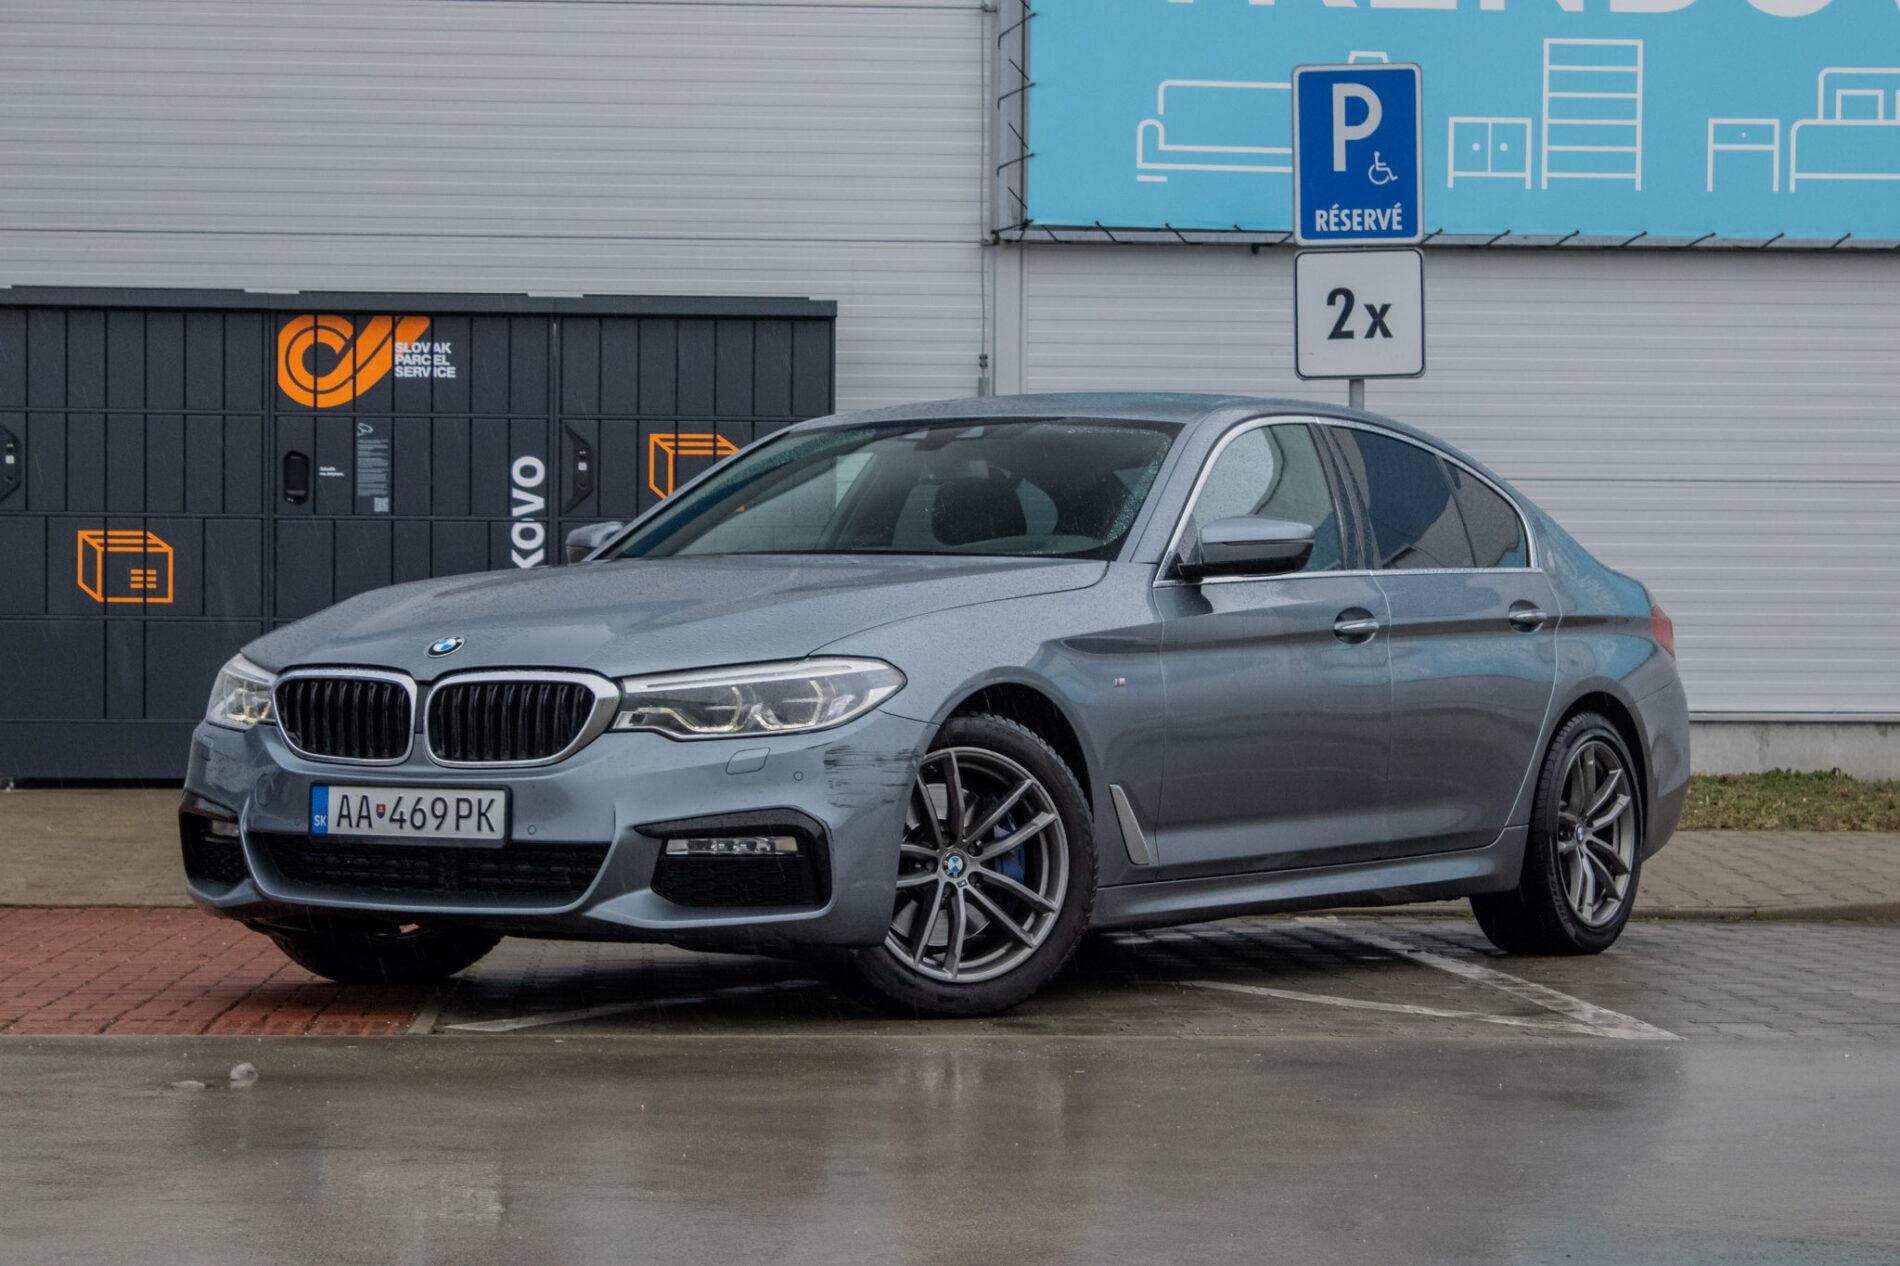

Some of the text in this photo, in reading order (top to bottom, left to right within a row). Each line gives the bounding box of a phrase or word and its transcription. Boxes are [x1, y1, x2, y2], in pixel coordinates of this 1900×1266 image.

[1332, 82, 1383, 172] P
[1315, 203, 1403, 232] RÉSERVÉ
[395, 342, 452, 354] SLOVAK
[395, 354, 450, 366] PARCEL
[395, 366, 456, 378] SERVICE
[314, 814, 327, 828] SK
